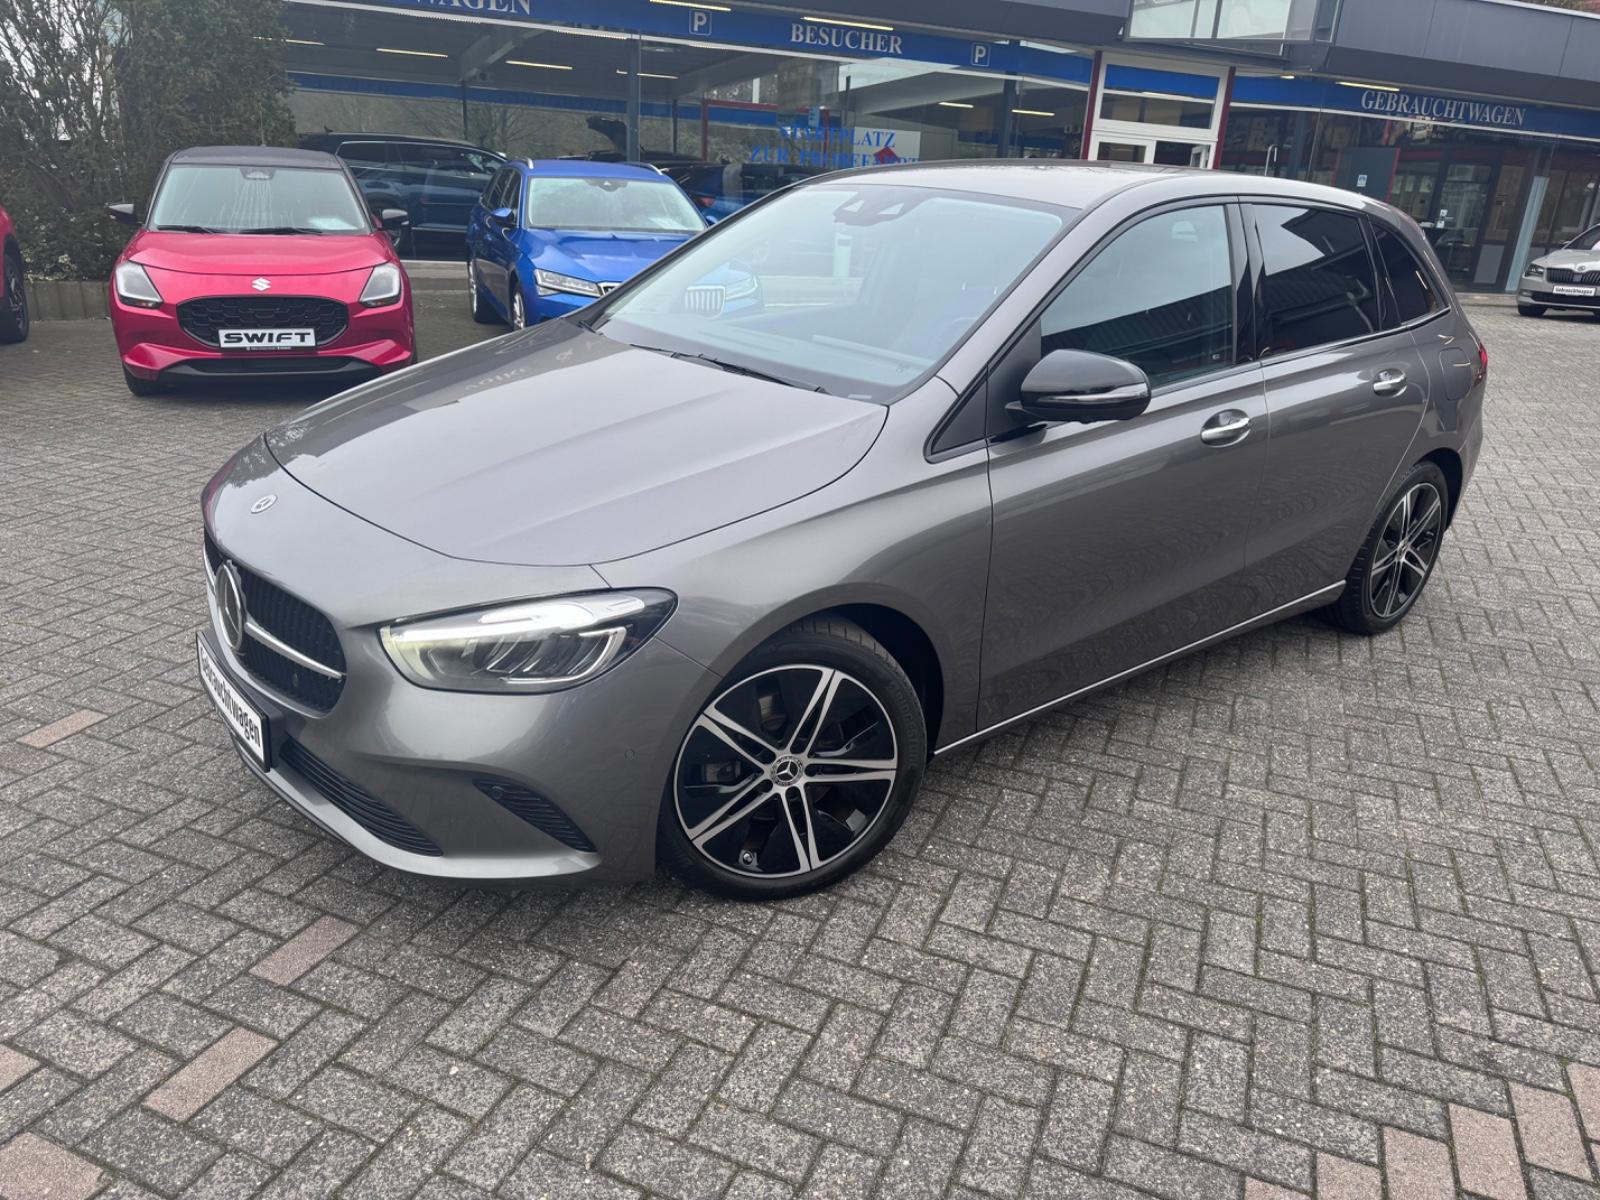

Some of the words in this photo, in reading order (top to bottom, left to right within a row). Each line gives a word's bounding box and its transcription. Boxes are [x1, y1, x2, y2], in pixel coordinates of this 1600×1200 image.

[694, 13, 707, 32] P
[791, 23, 902, 54] BESUCHER
[974, 46, 986, 63] P
[1361, 90, 1525, 125] GEBRAUCHTWAGEN
[223, 332, 311, 344] SWIFT
[200, 646, 261, 748] Gebrauchtwagen
